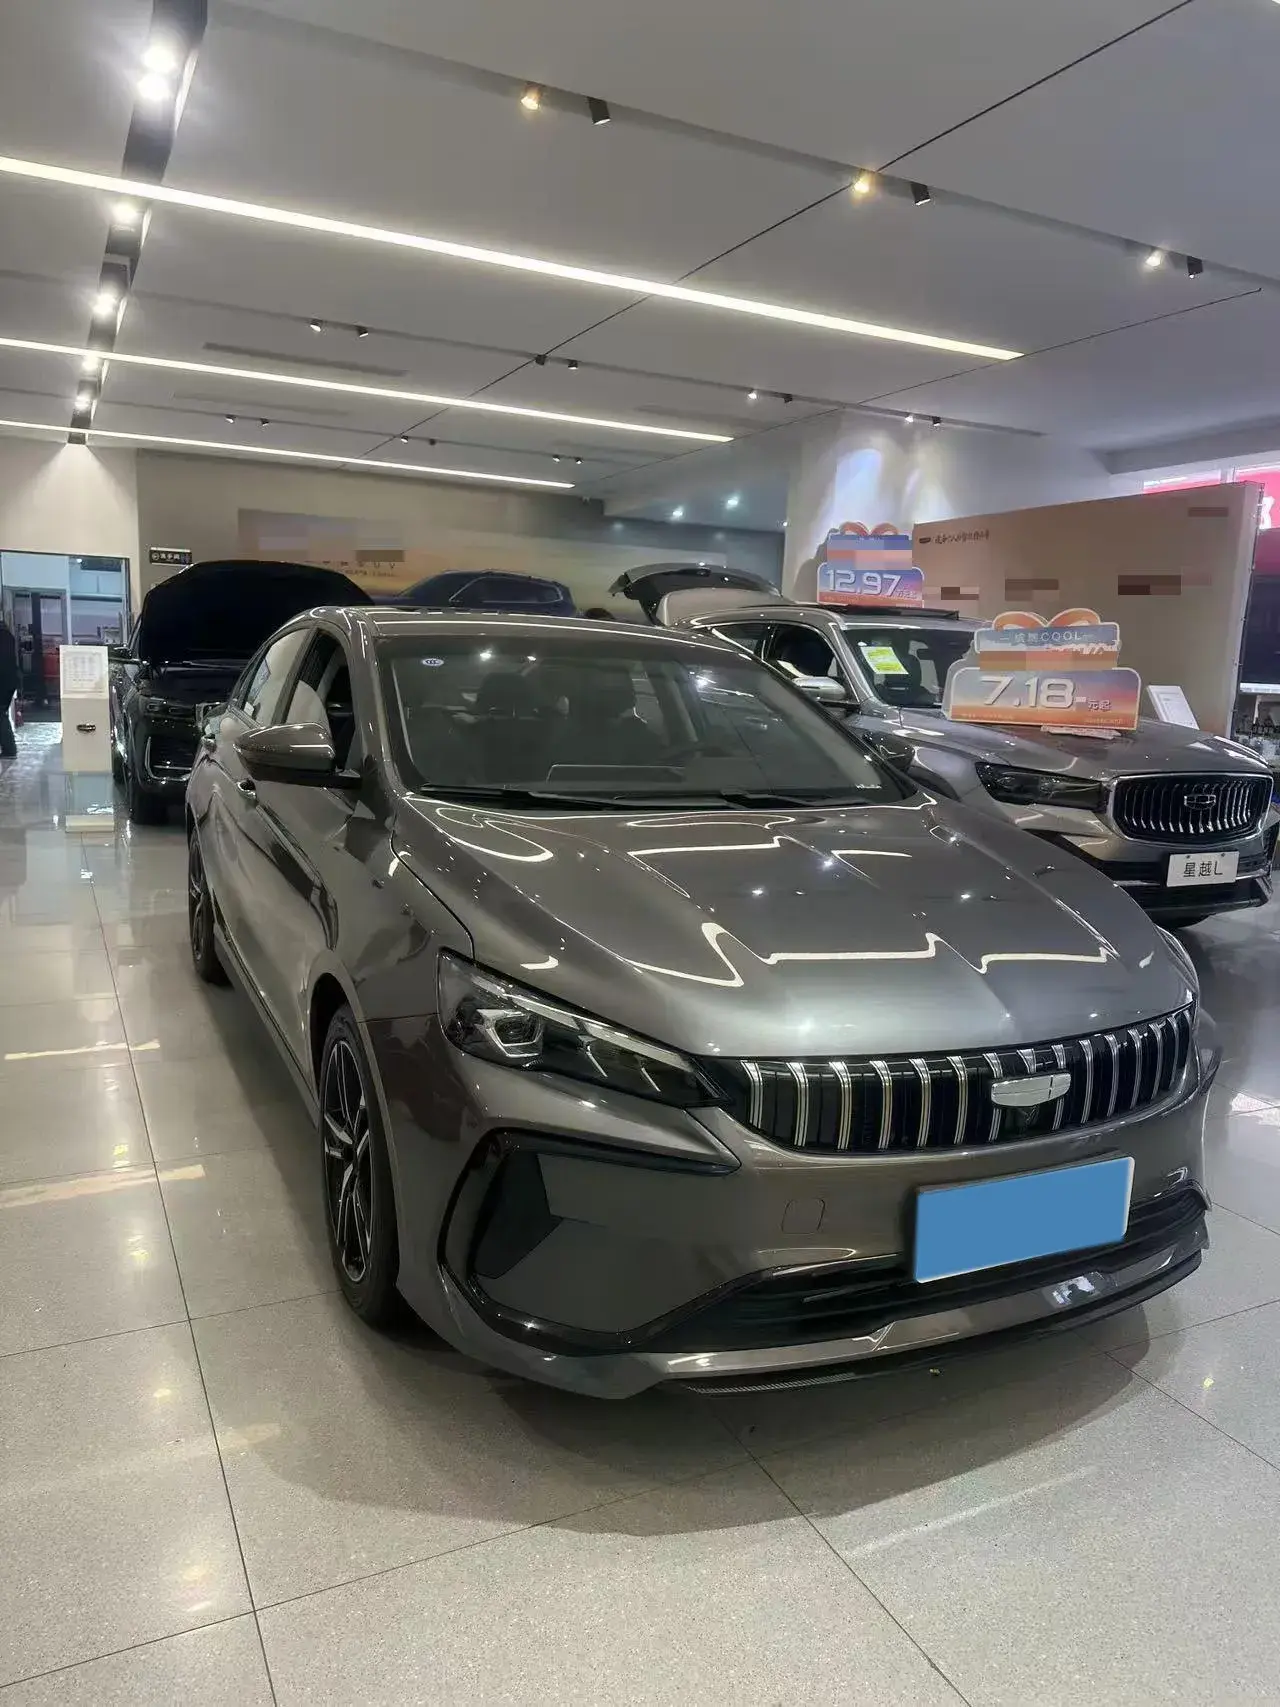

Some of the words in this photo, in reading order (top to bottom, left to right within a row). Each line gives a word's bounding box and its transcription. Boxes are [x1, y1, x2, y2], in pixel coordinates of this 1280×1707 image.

[826, 569, 902, 597] 12.97
[980, 676, 1076, 709] 7.18
[1183, 860, 1223, 877] 星越L
